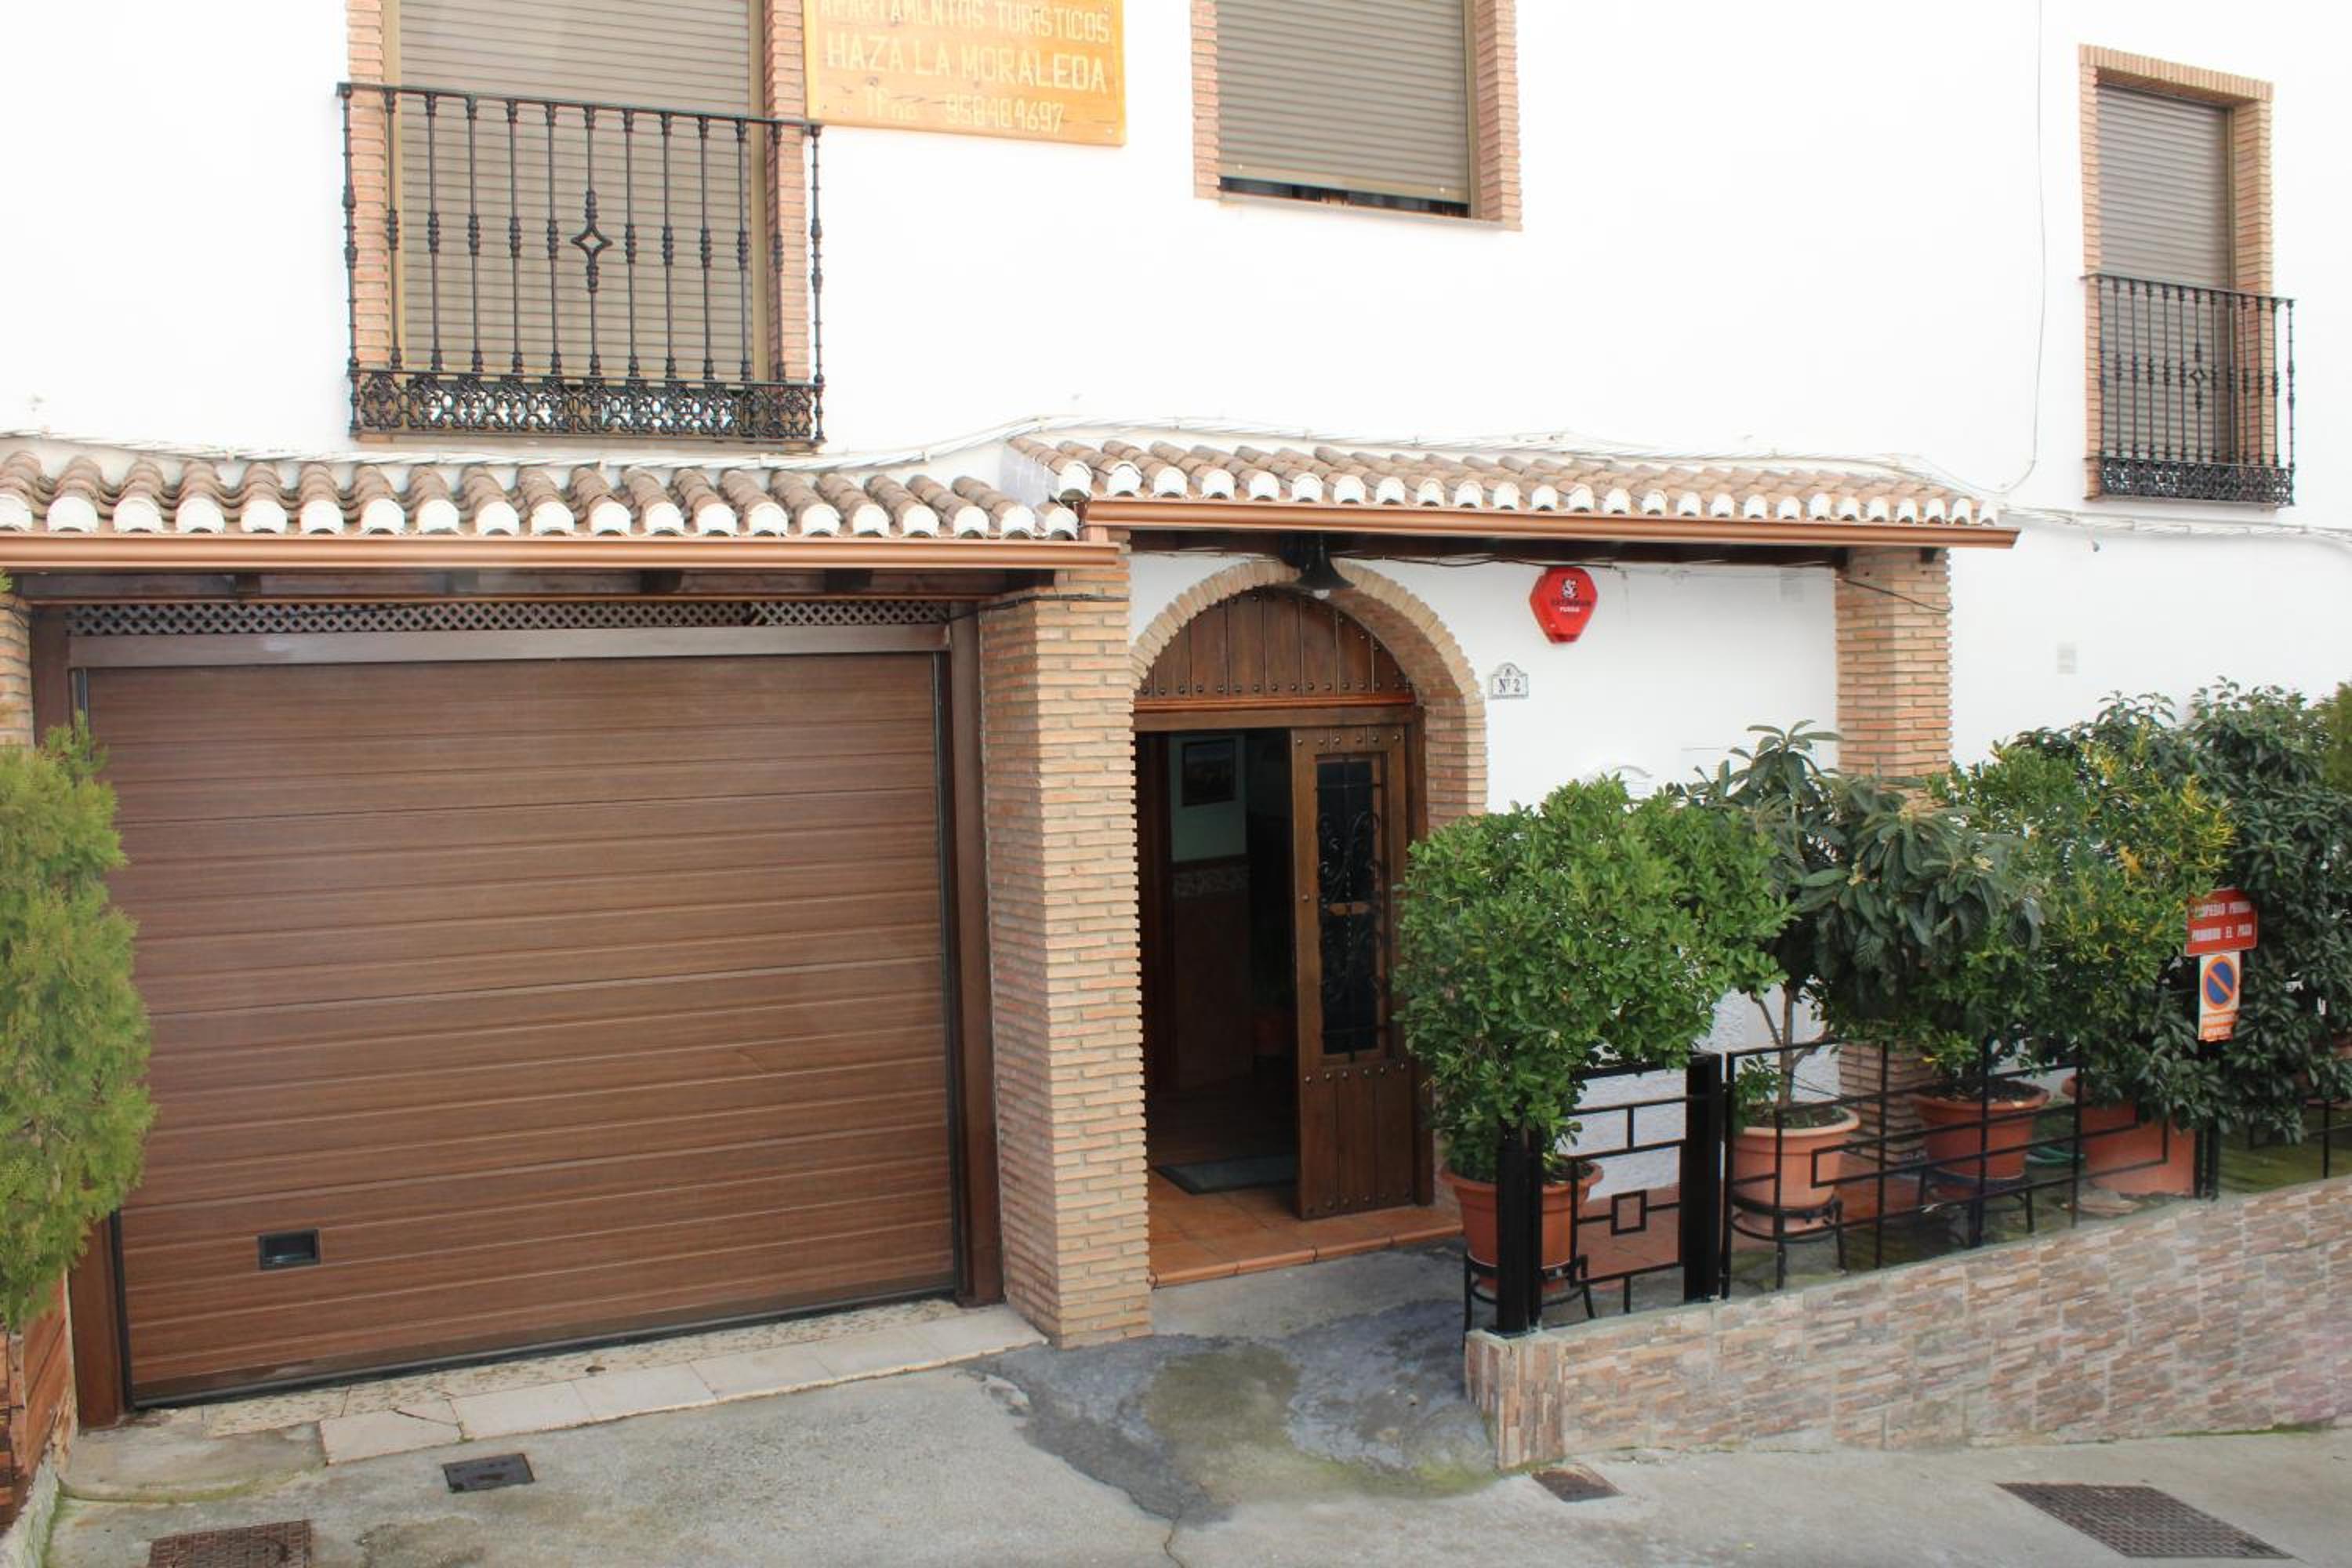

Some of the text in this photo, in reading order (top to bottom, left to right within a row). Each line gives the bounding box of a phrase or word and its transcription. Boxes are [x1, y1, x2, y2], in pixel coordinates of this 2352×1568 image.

[826, 30, 1108, 94] HAZA LA MORALEDA
[1512, 678, 1521, 692] 2
